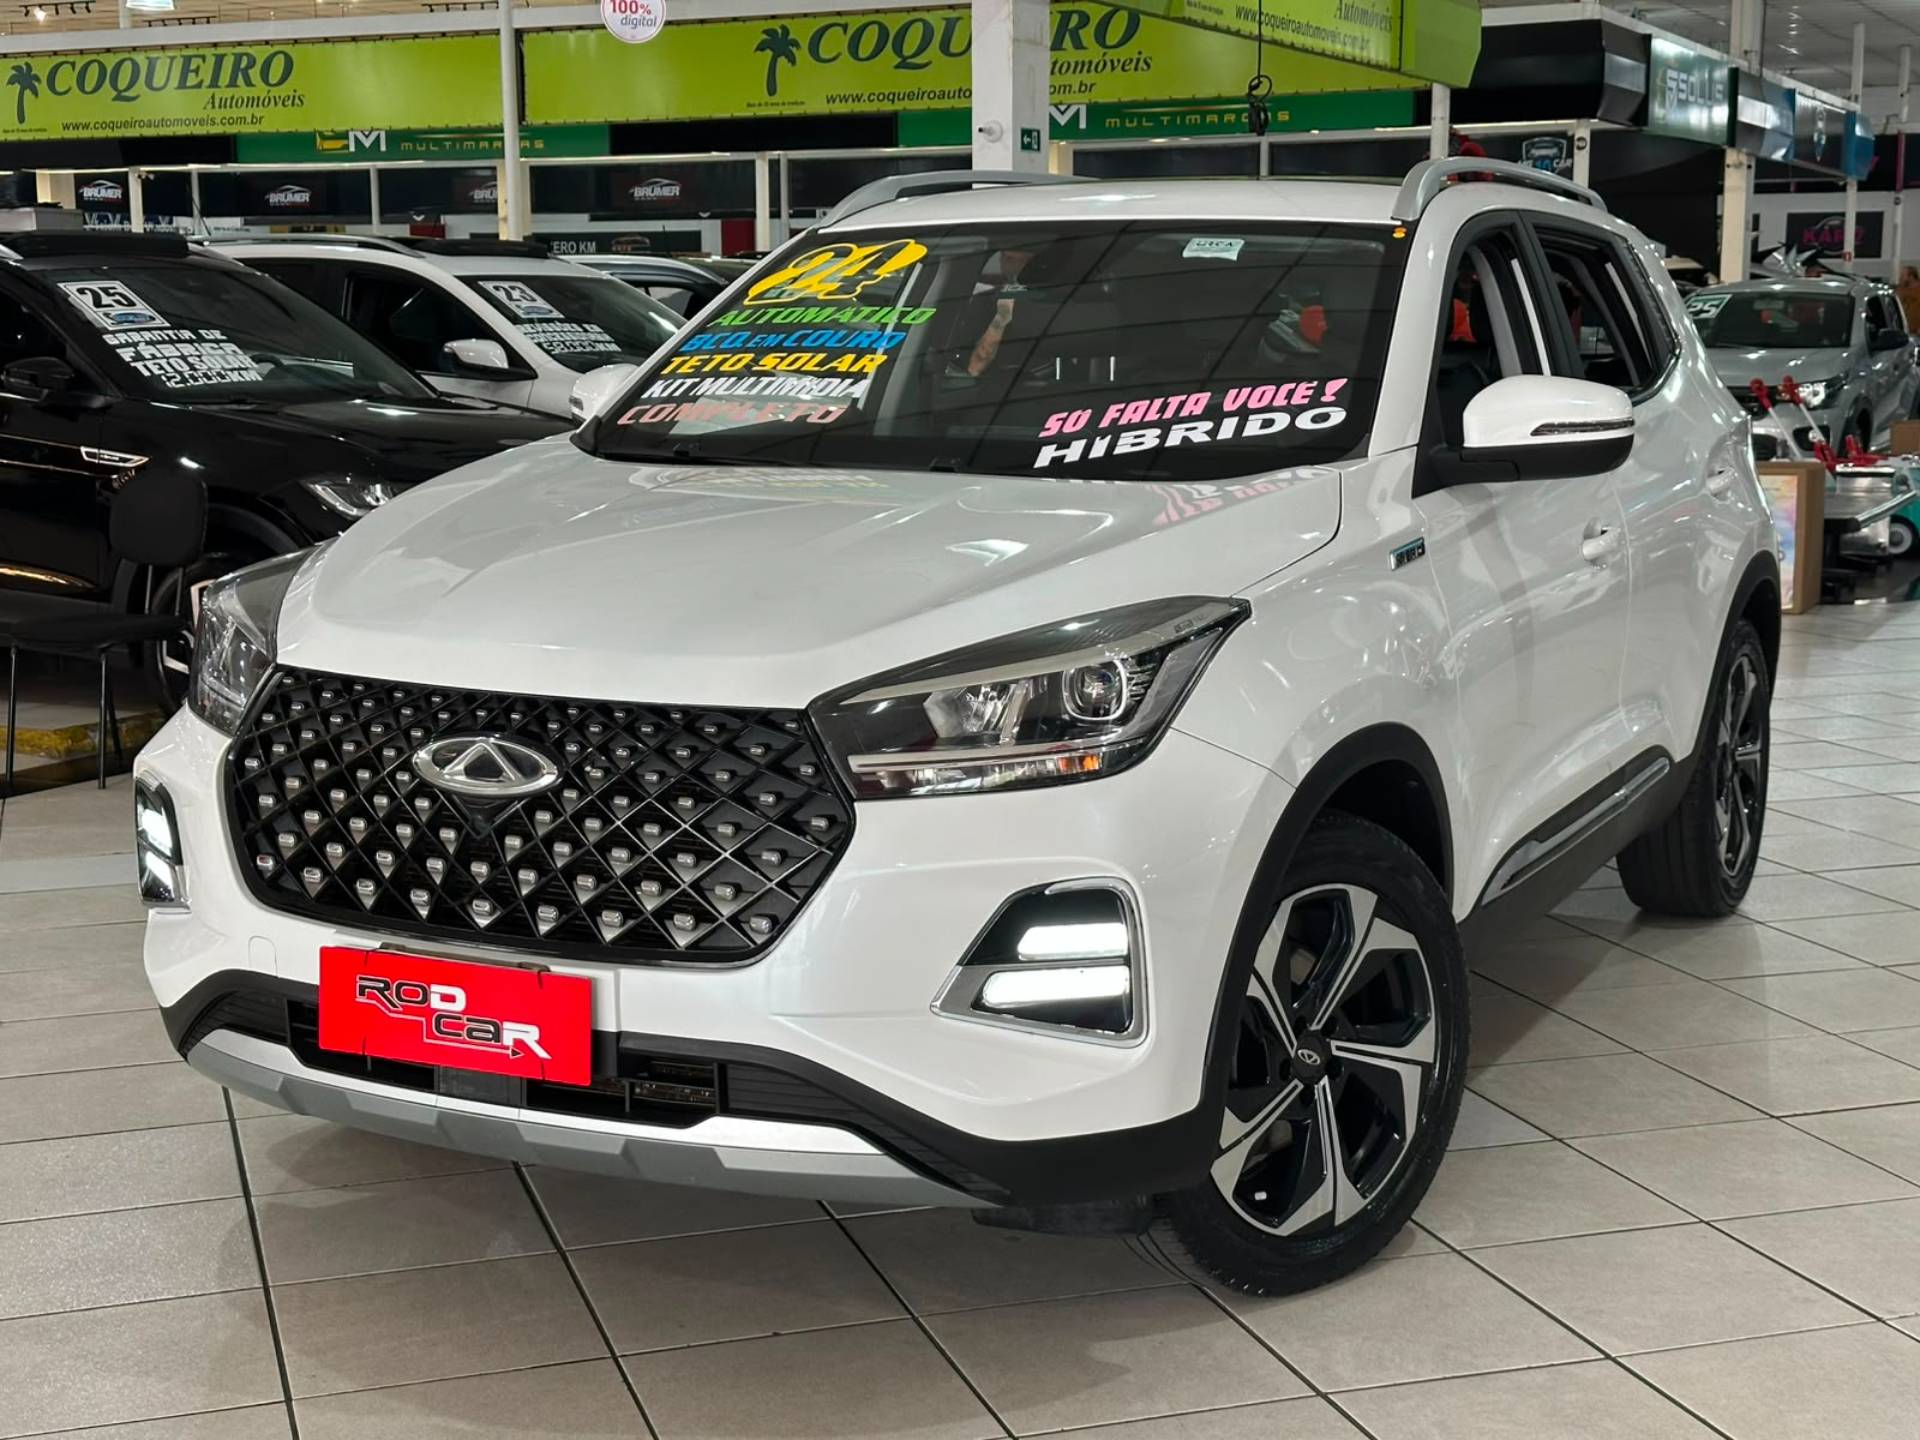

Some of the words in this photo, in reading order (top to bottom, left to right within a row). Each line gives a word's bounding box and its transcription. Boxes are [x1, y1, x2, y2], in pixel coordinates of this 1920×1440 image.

[620, 14, 657, 30] digital
[46, 50, 294, 102] COQUEIRO
[202, 88, 305, 112] Automóveis
[62, 113, 264, 132] www.coqueiroautomoveis.com.br
[401, 139, 544, 151] MULTIMARAS
[551, 240, 577, 254] ERO
[579, 240, 597, 253] KM
[76, 286, 138, 309] 25
[492, 285, 538, 302] 23
[102, 329, 197, 346] GARANTIA
[198, 329, 228, 340] DE
[783, 329, 907, 350] COURO
[129, 357, 190, 377] TETO
[187, 354, 260, 371] SOLAR
[660, 353, 755, 374] TETO
[751, 352, 888, 373] SOLAR
[640, 378, 701, 398] KIT
[617, 402, 847, 425] COMPLETO
[1098, 391, 1212, 428] FALTA
